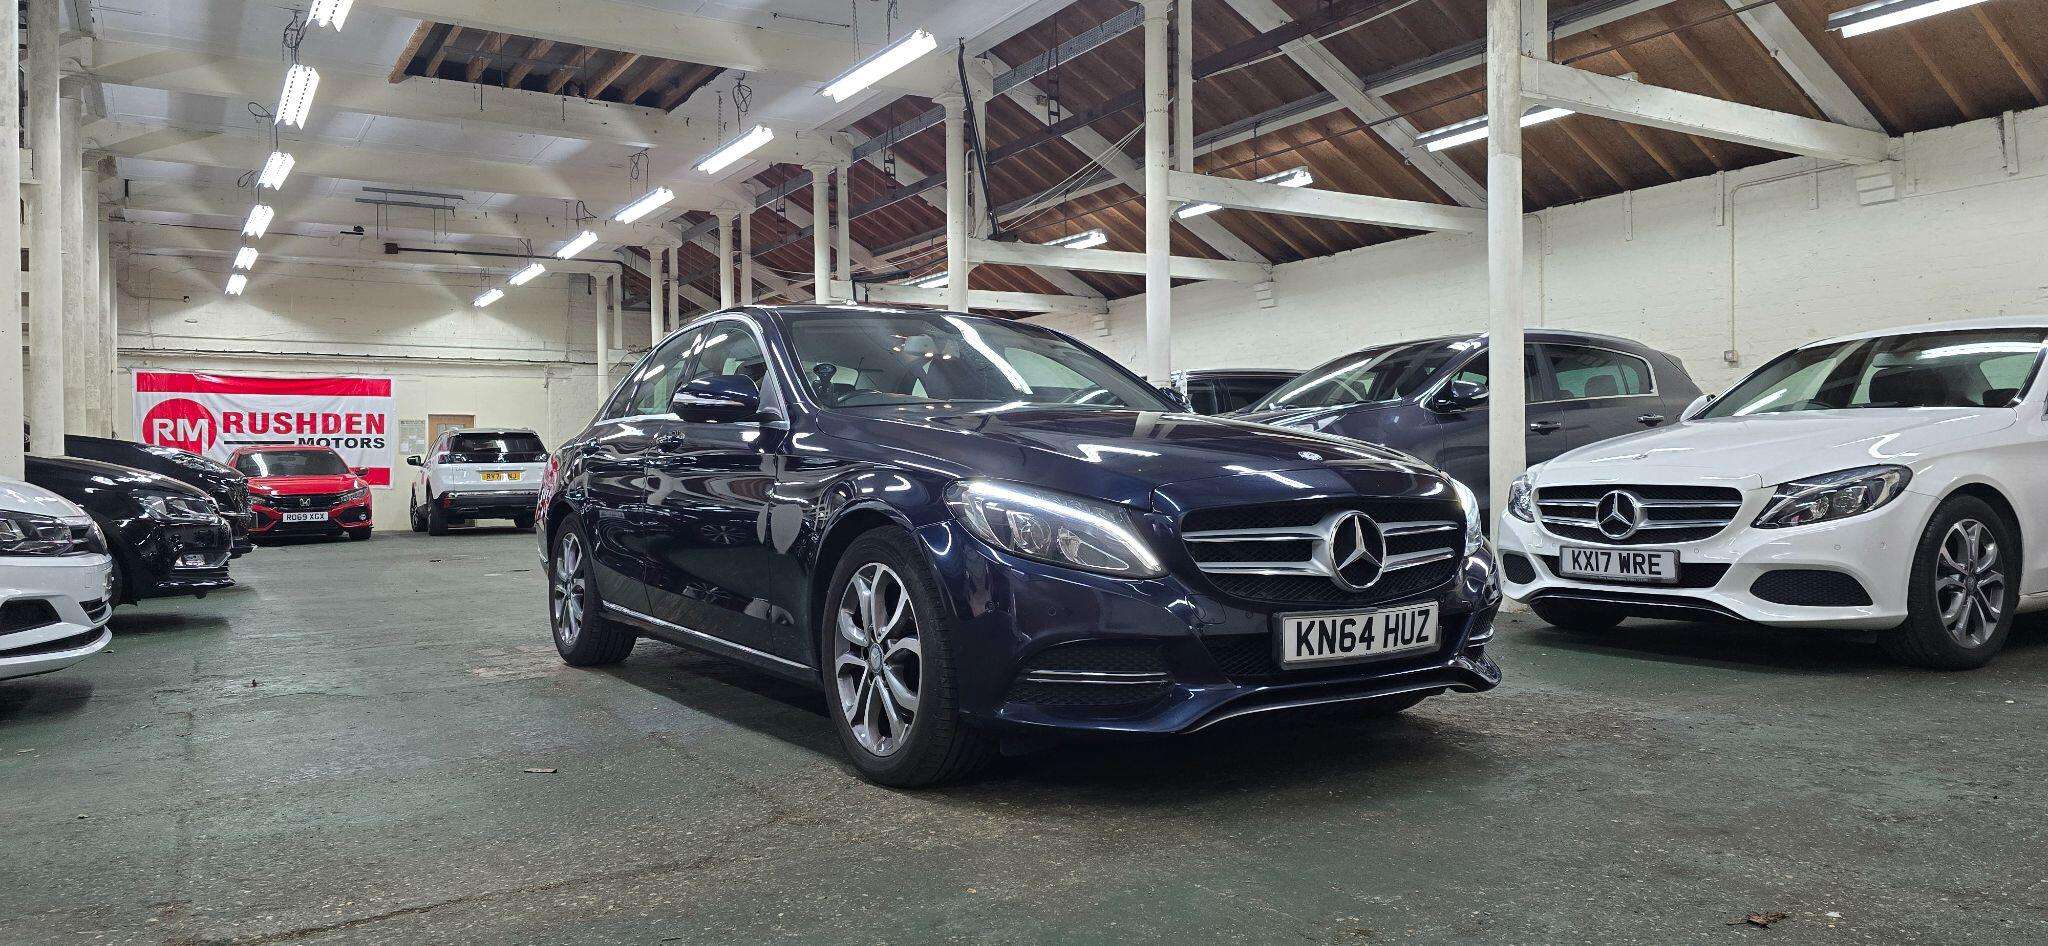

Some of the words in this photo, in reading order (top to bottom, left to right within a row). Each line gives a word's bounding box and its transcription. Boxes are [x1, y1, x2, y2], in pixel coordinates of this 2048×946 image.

[152, 418, 209, 451] RM
[222, 411, 385, 435] RUSHDEN
[298, 437, 385, 449] MOTORS
[1571, 549, 1611, 573] KX17
[1618, 552, 1662, 576] WRE
[1296, 616, 1375, 657] KN64
[1383, 608, 1430, 649] HUZ
